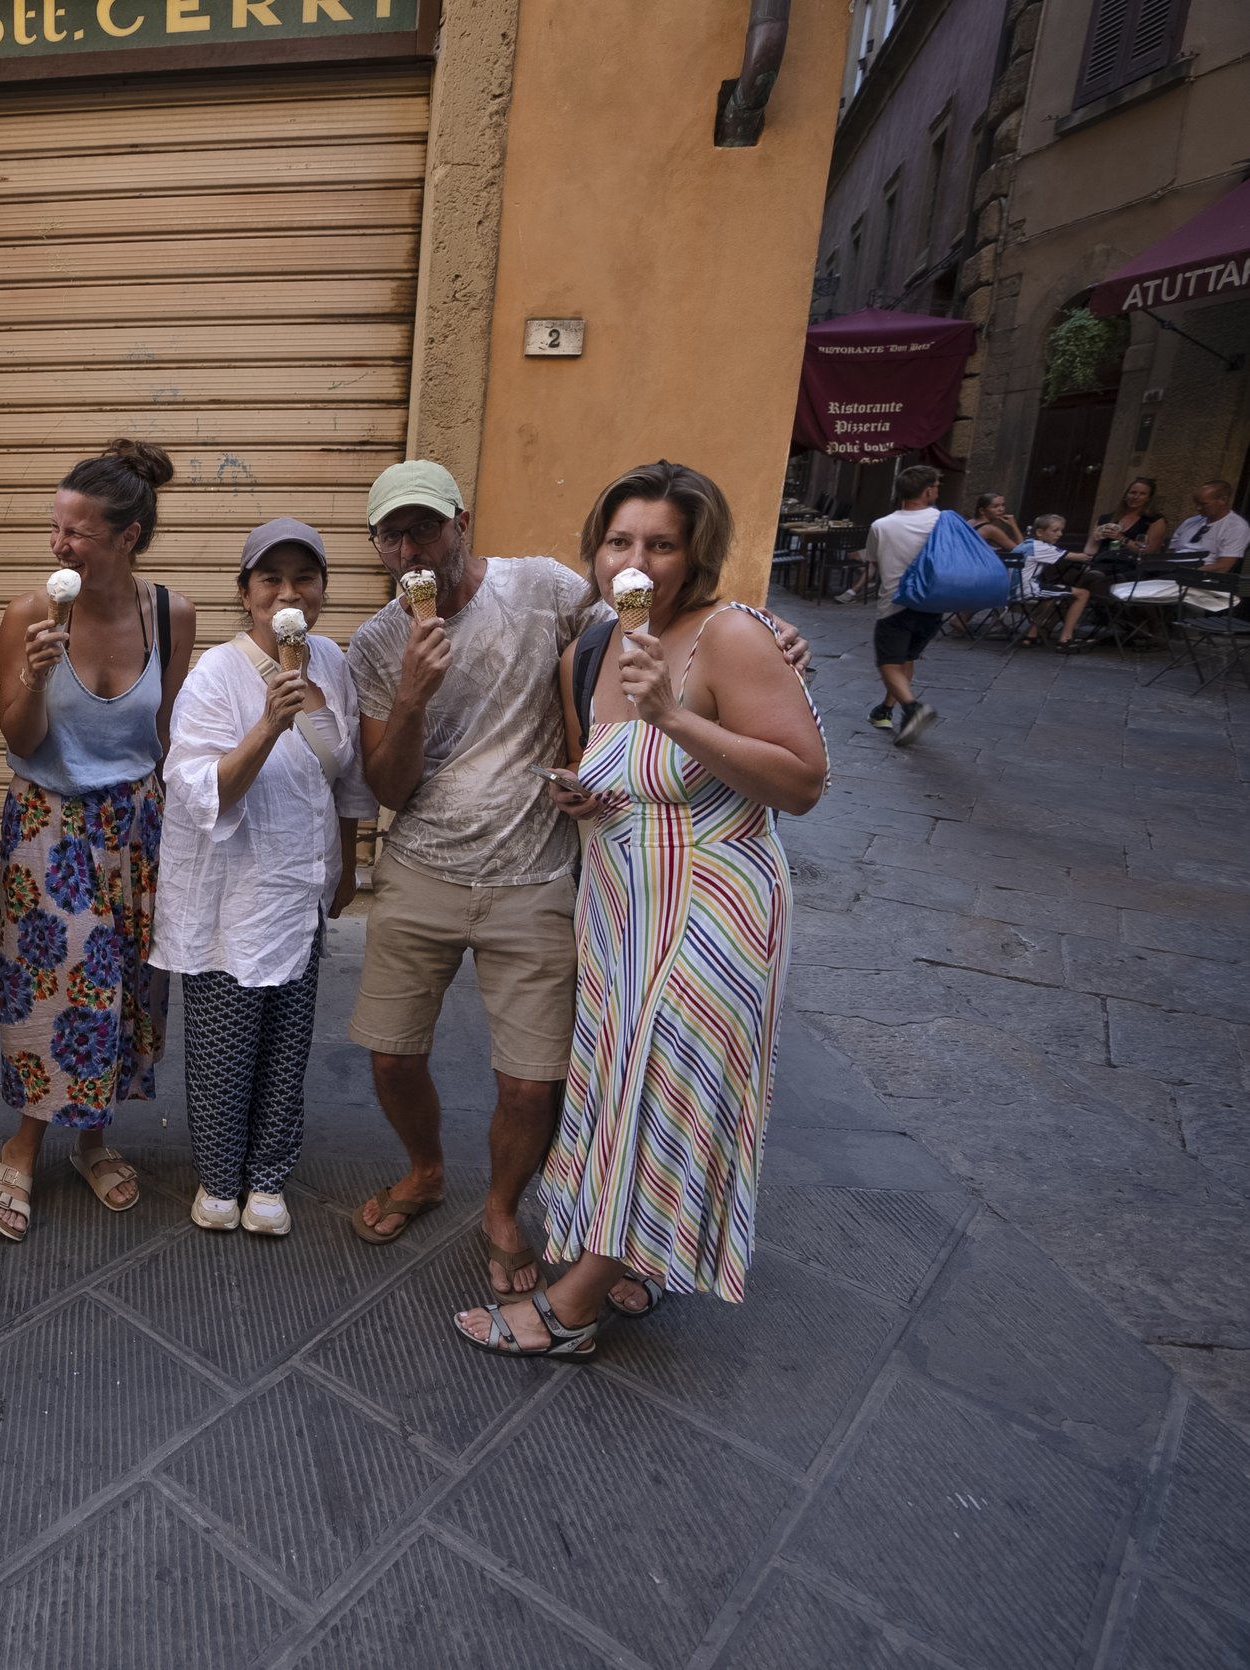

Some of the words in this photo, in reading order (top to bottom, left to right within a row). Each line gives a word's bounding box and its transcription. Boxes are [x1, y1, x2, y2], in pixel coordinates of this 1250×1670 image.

[548, 328, 561, 348] 2
[817, 345, 885, 354] RISTORANTE
[827, 401, 904, 415] Ristorante
[833, 420, 891, 435] Pizzeria
